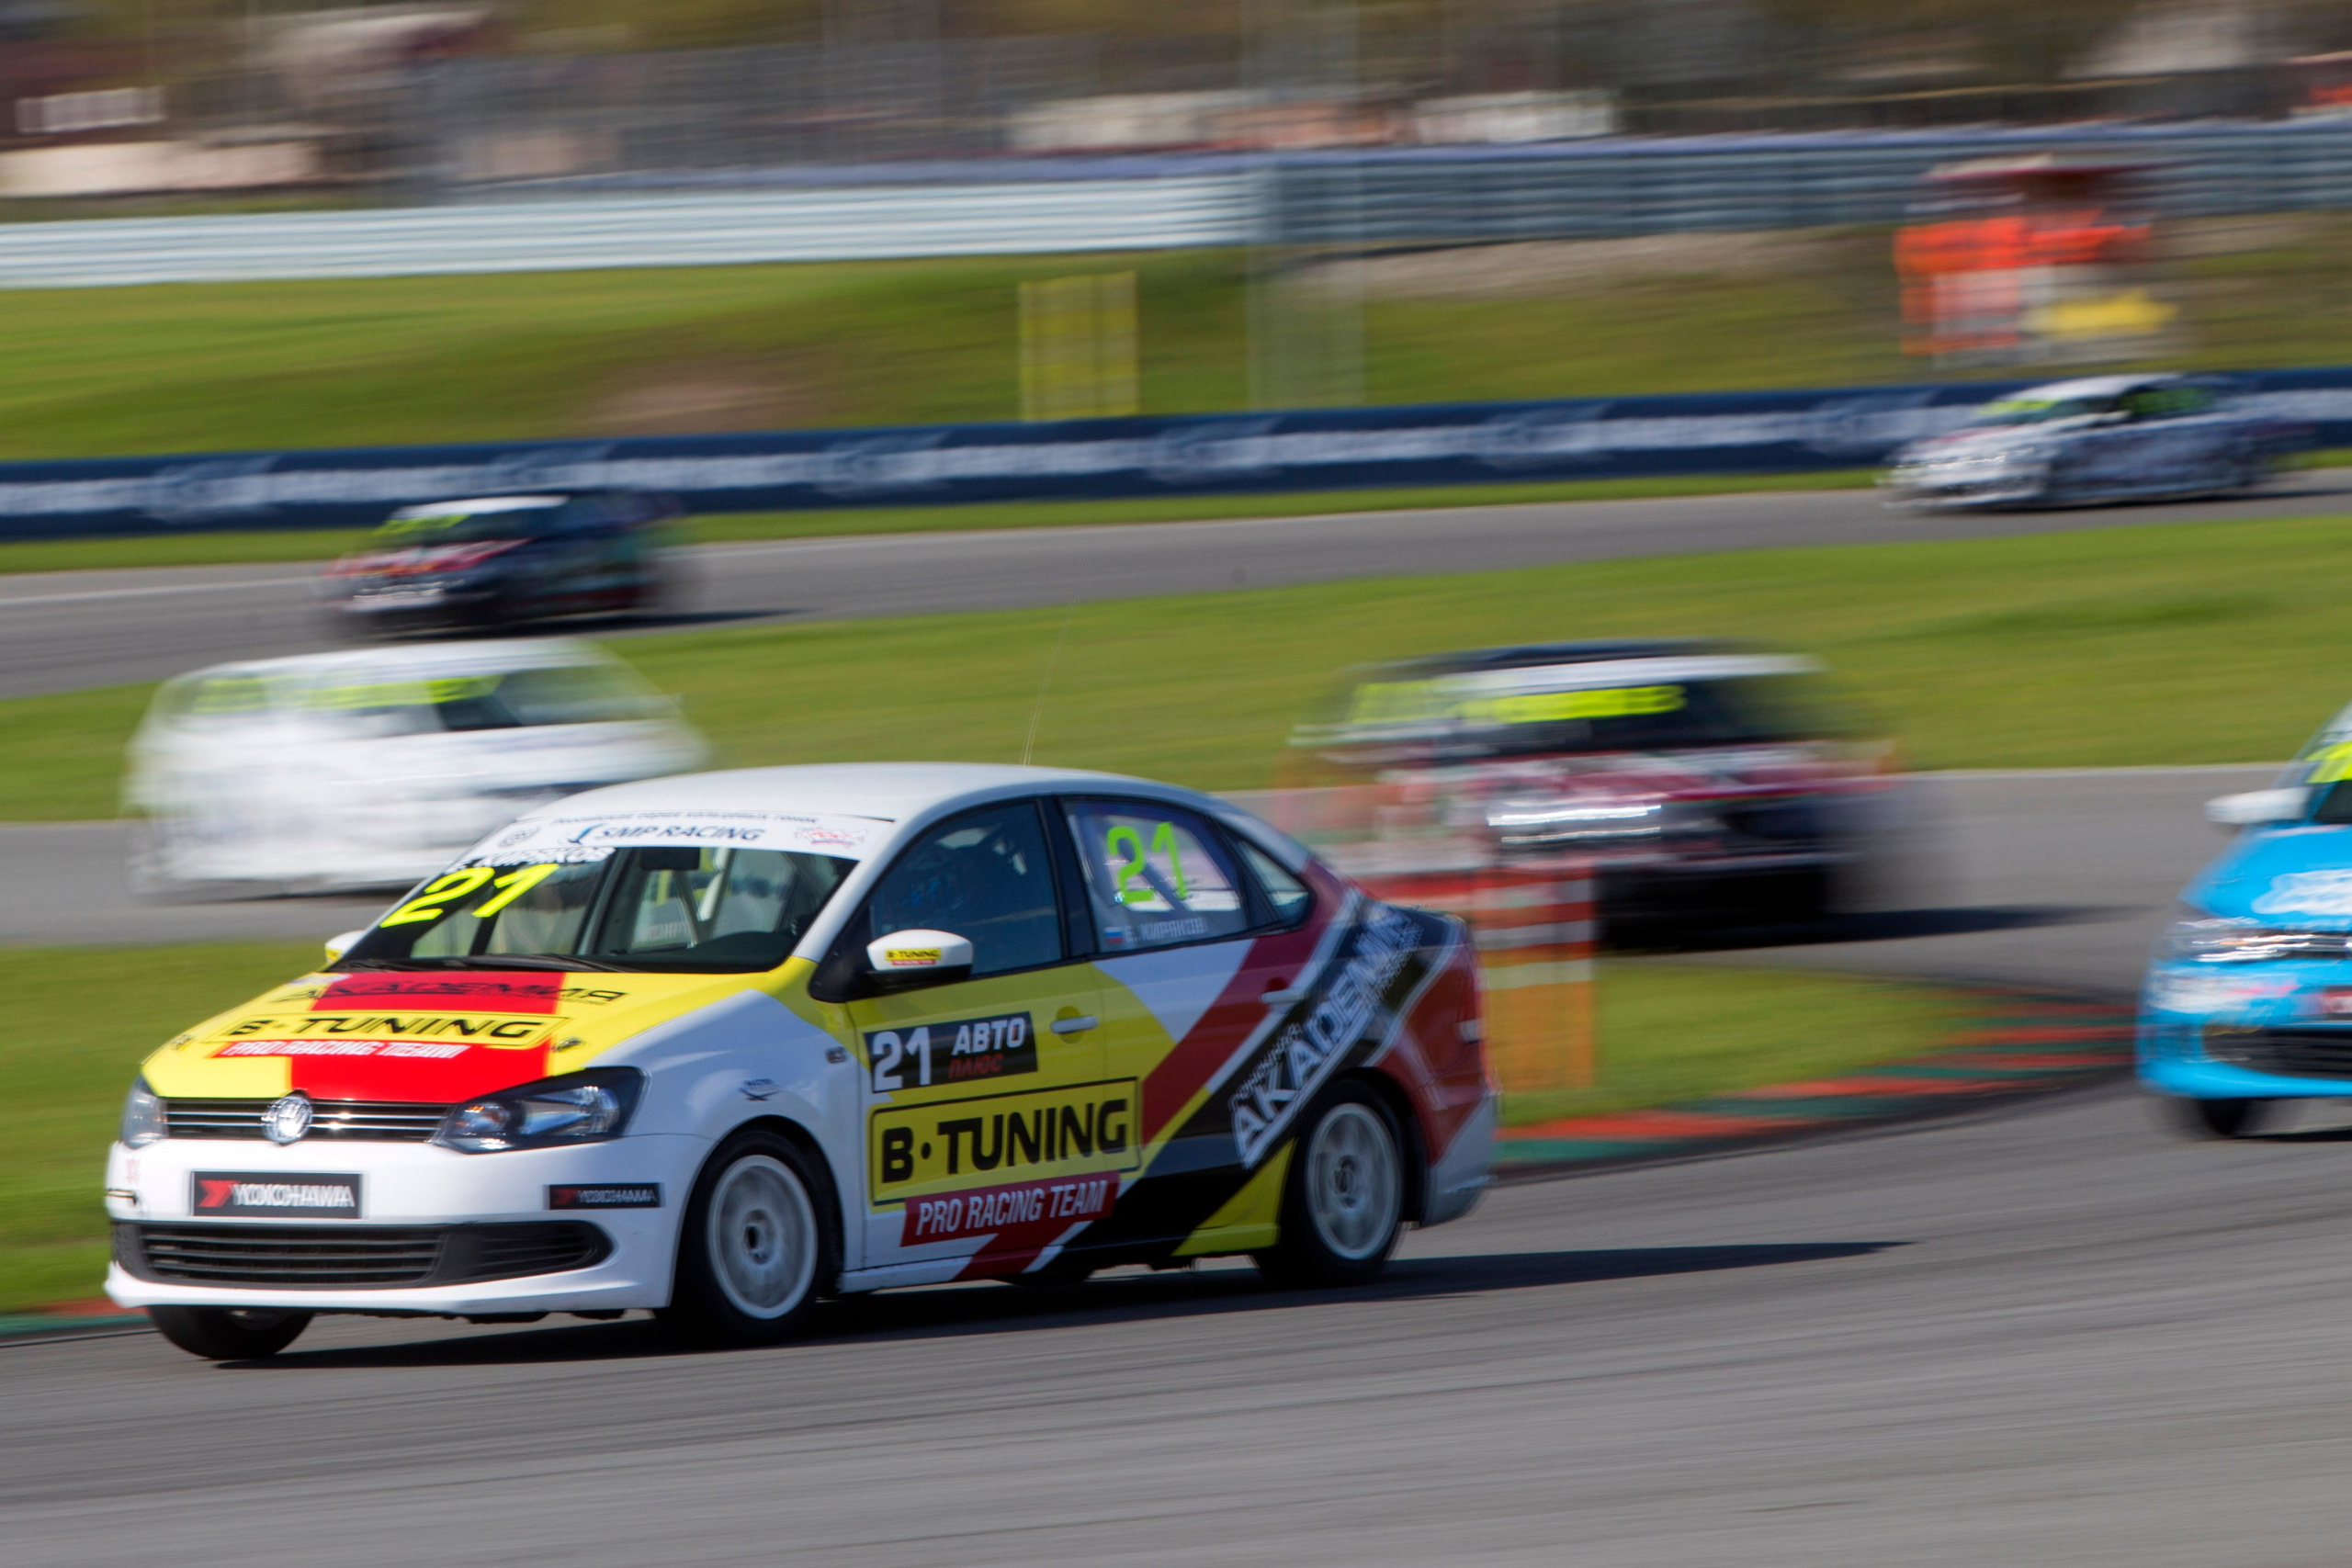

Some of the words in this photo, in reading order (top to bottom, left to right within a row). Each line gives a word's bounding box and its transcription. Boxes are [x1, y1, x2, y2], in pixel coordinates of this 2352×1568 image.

[657, 826, 766, 840] RACING
[1106, 820, 1187, 906] 21
[379, 863, 560, 928] 21
[221, 1040, 288, 1055] PRO
[277, 1040, 386, 1056] RACING
[378, 1042, 471, 1058] TEAM
[873, 1025, 933, 1092] 21
[230, 1183, 356, 1207] YOKOHAMA
[576, 1189, 658, 1204] YOKOHAMA
[915, 1199, 964, 1236] PRO
[965, 1188, 1045, 1230] RACING
[1048, 1179, 1109, 1218] TEAM
